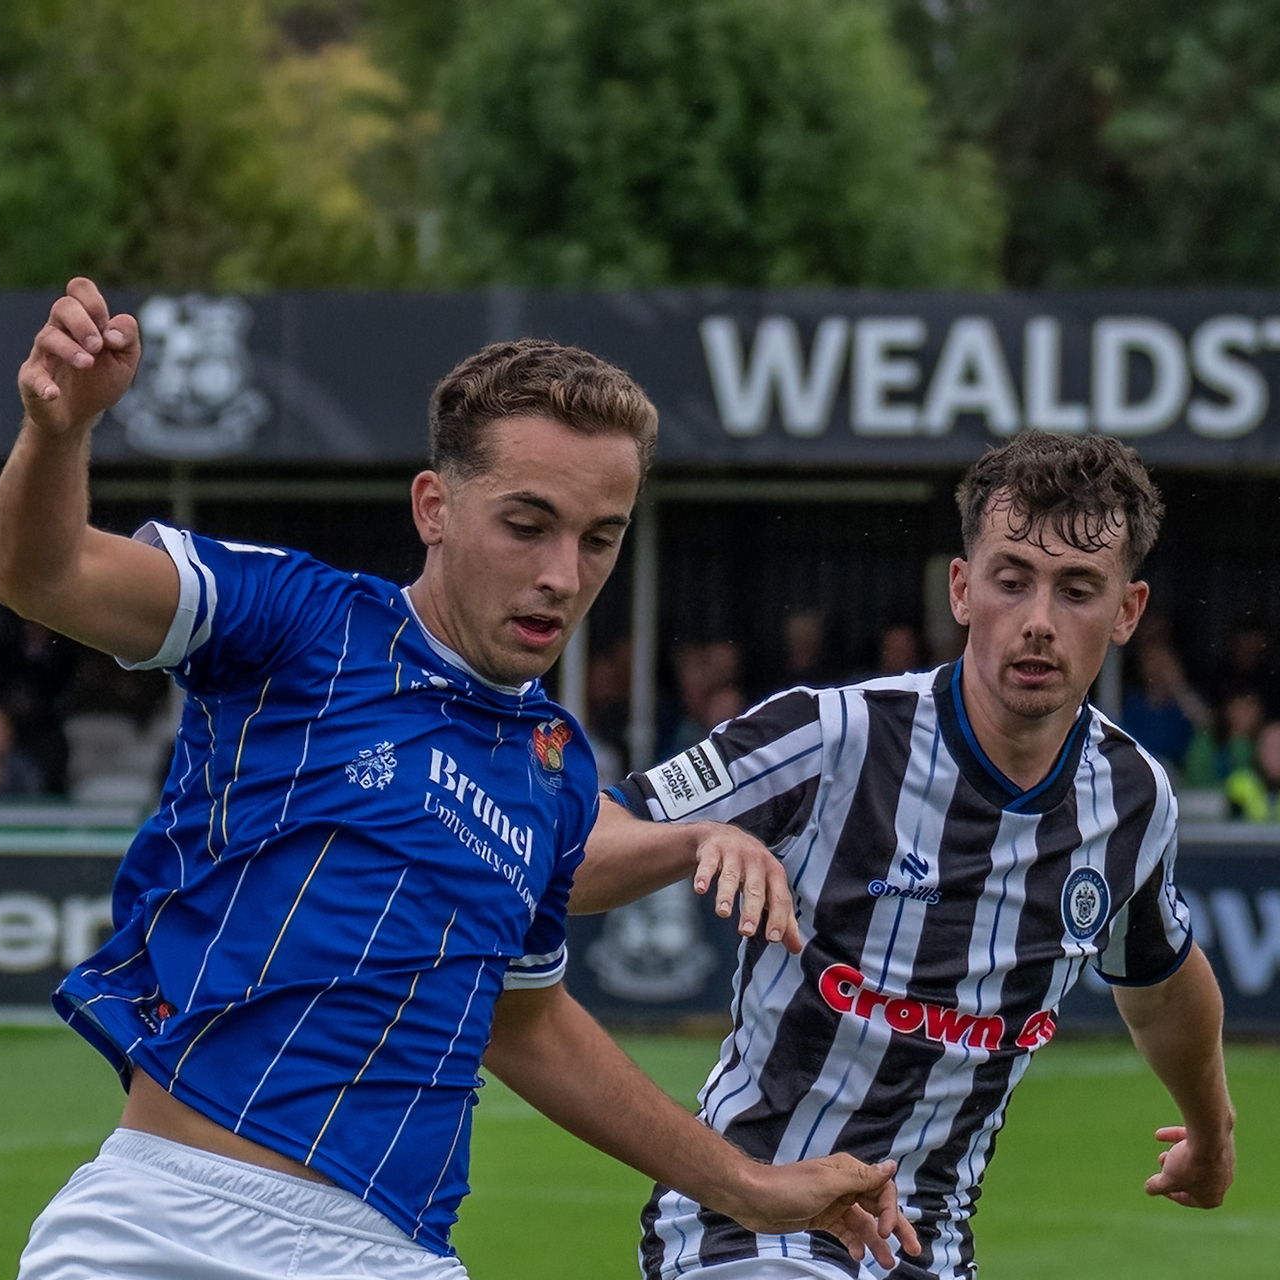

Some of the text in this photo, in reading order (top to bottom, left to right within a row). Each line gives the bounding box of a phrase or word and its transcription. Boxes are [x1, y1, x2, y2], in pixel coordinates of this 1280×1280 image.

[428, 747, 534, 868] Brunel
[661, 766, 685, 801] LEAGUE
[670, 760, 695, 801] NATIONAL
[423, 791, 504, 873] University
[503, 863, 521, 886] of
[818, 963, 1005, 1050] Crown
